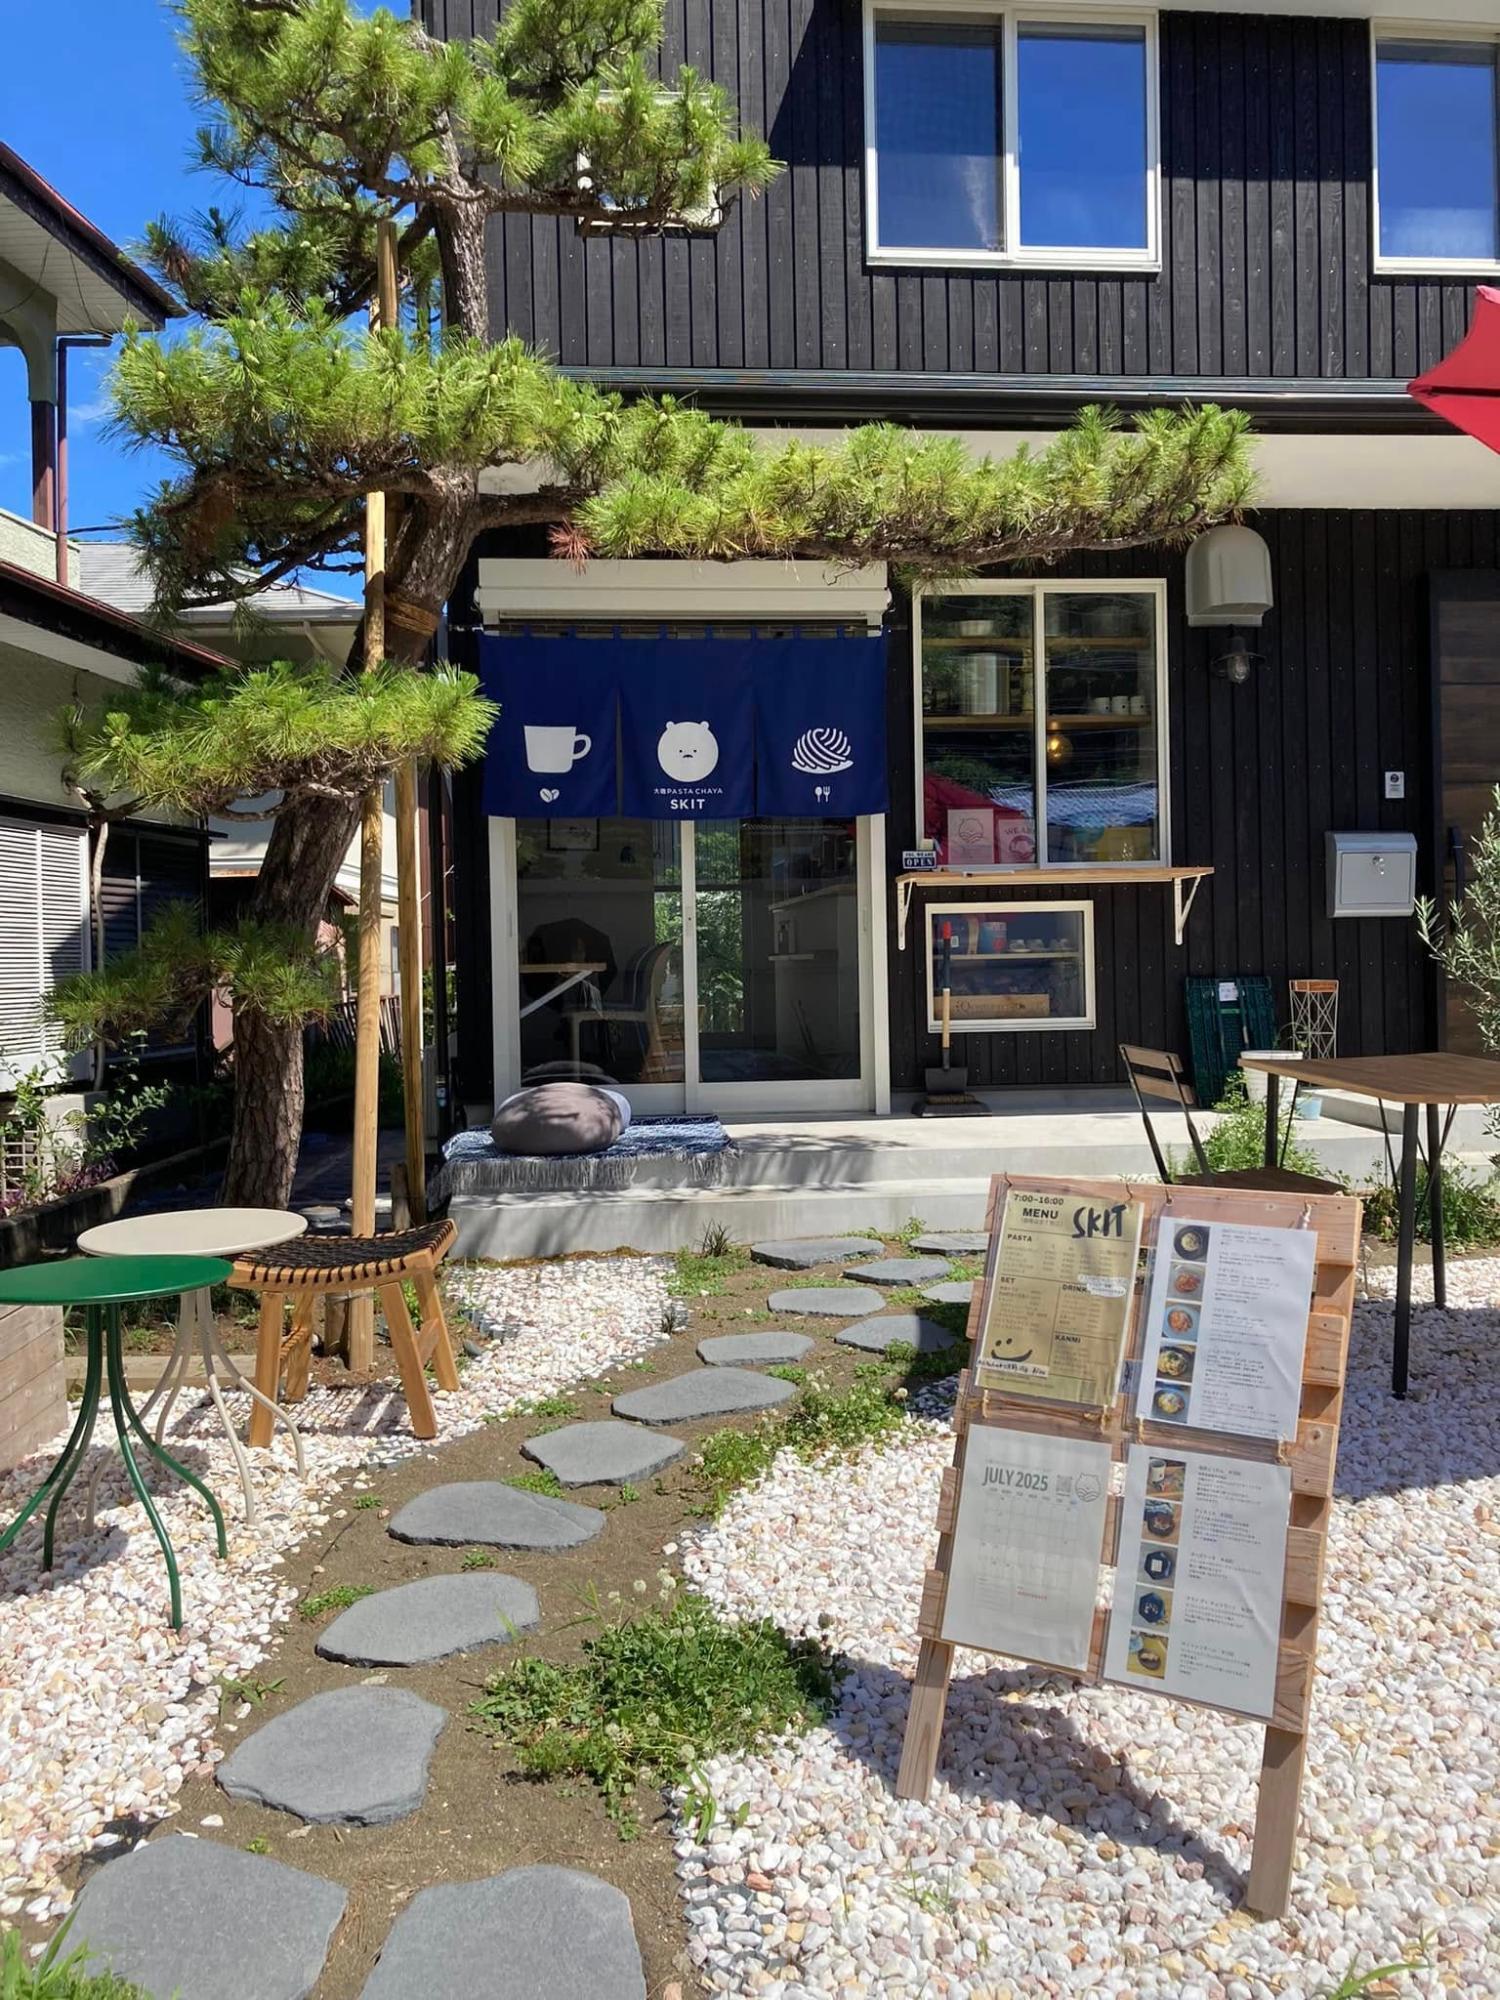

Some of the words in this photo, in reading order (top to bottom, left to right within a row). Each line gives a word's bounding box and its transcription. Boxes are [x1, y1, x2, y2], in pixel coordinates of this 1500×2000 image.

[695, 787, 723, 795] CHAYA
[670, 799, 706, 810] SKIT
[906, 858, 933, 867] OPEN
[1013, 1194, 1064, 1206] 7:00-16:00
[1022, 1207, 1059, 1220] MENU
[1072, 1204, 1127, 1239] SKIT
[1007, 1233, 1033, 1243] PASTA
[981, 1466, 1015, 1486] JULY
[1015, 1471, 1048, 1492] 2025
